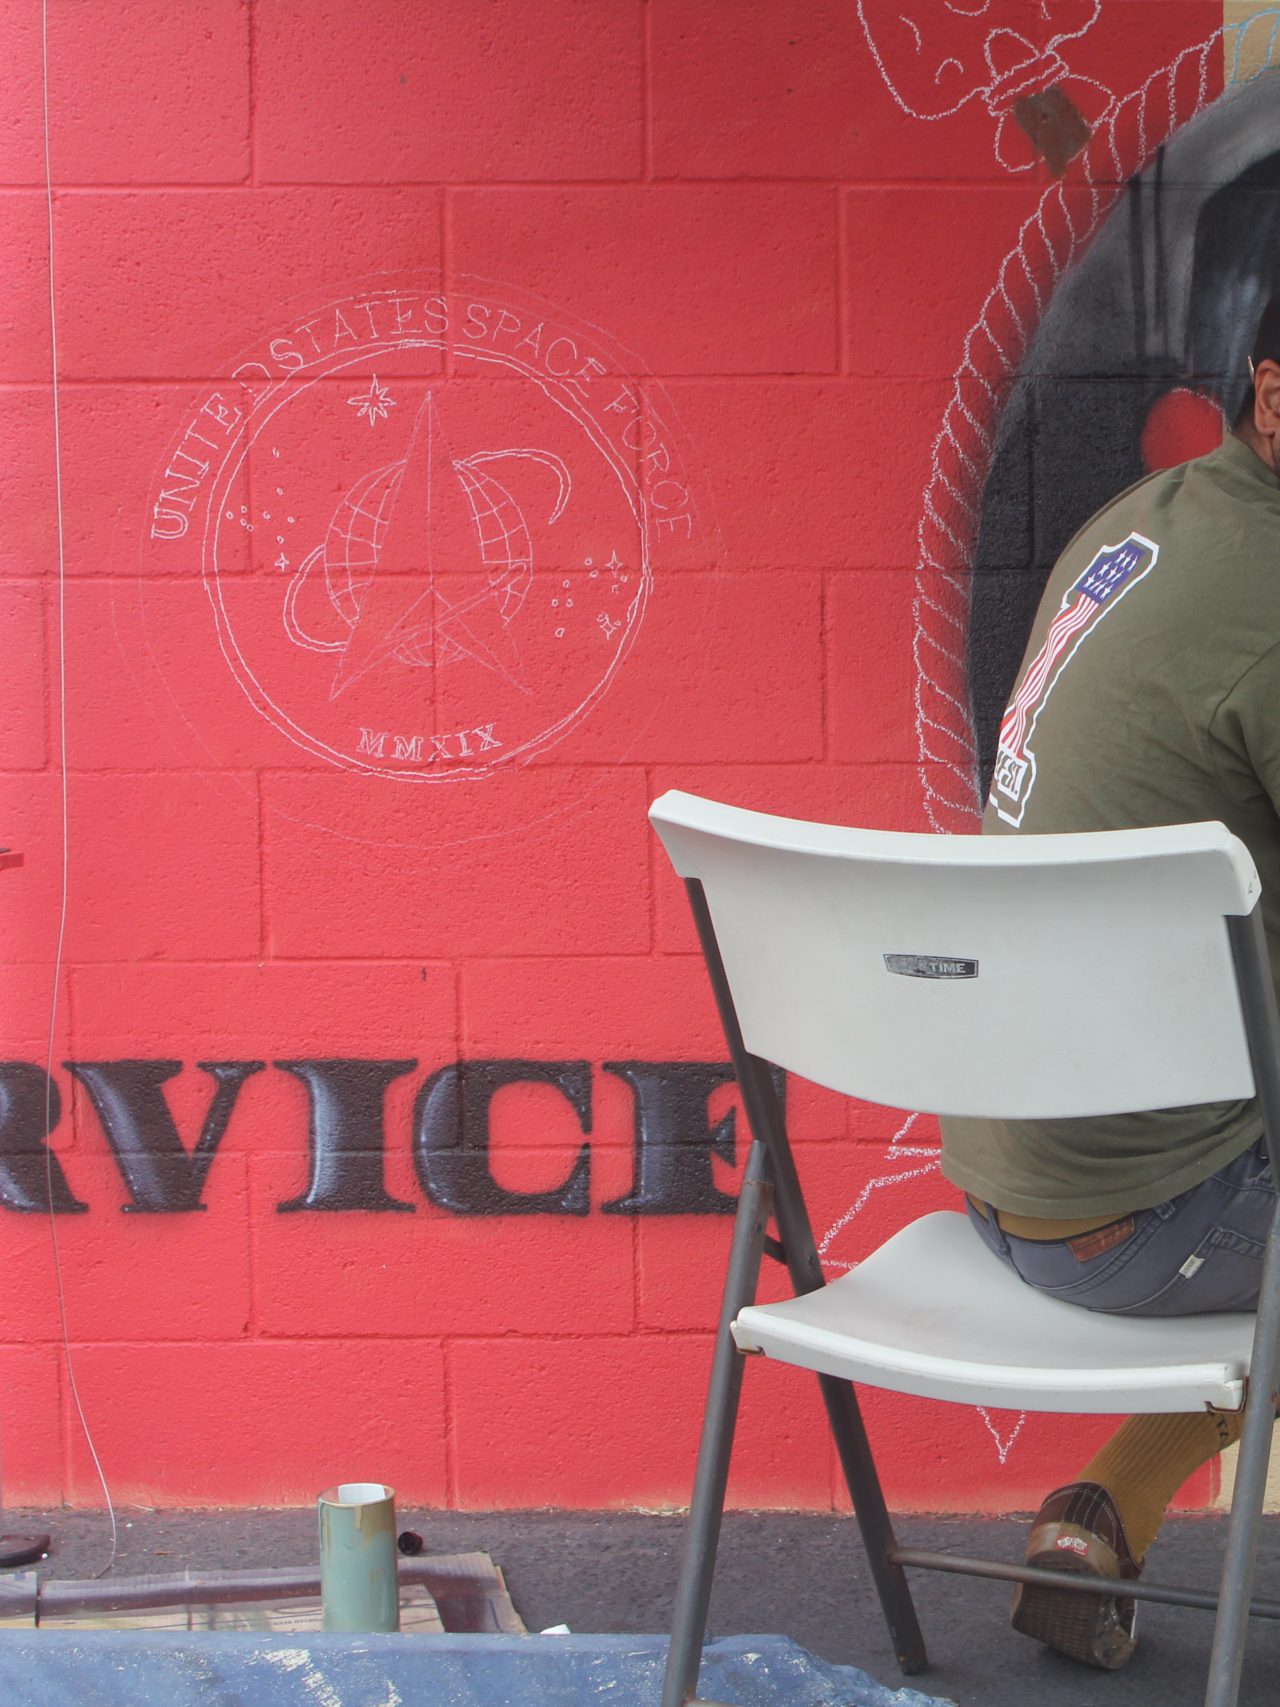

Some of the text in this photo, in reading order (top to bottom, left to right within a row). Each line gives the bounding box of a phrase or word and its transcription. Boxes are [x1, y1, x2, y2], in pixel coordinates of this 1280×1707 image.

[151, 297, 692, 543] UNITED STATES SPACE FORCE
[356, 722, 503, 762] MMXIX
